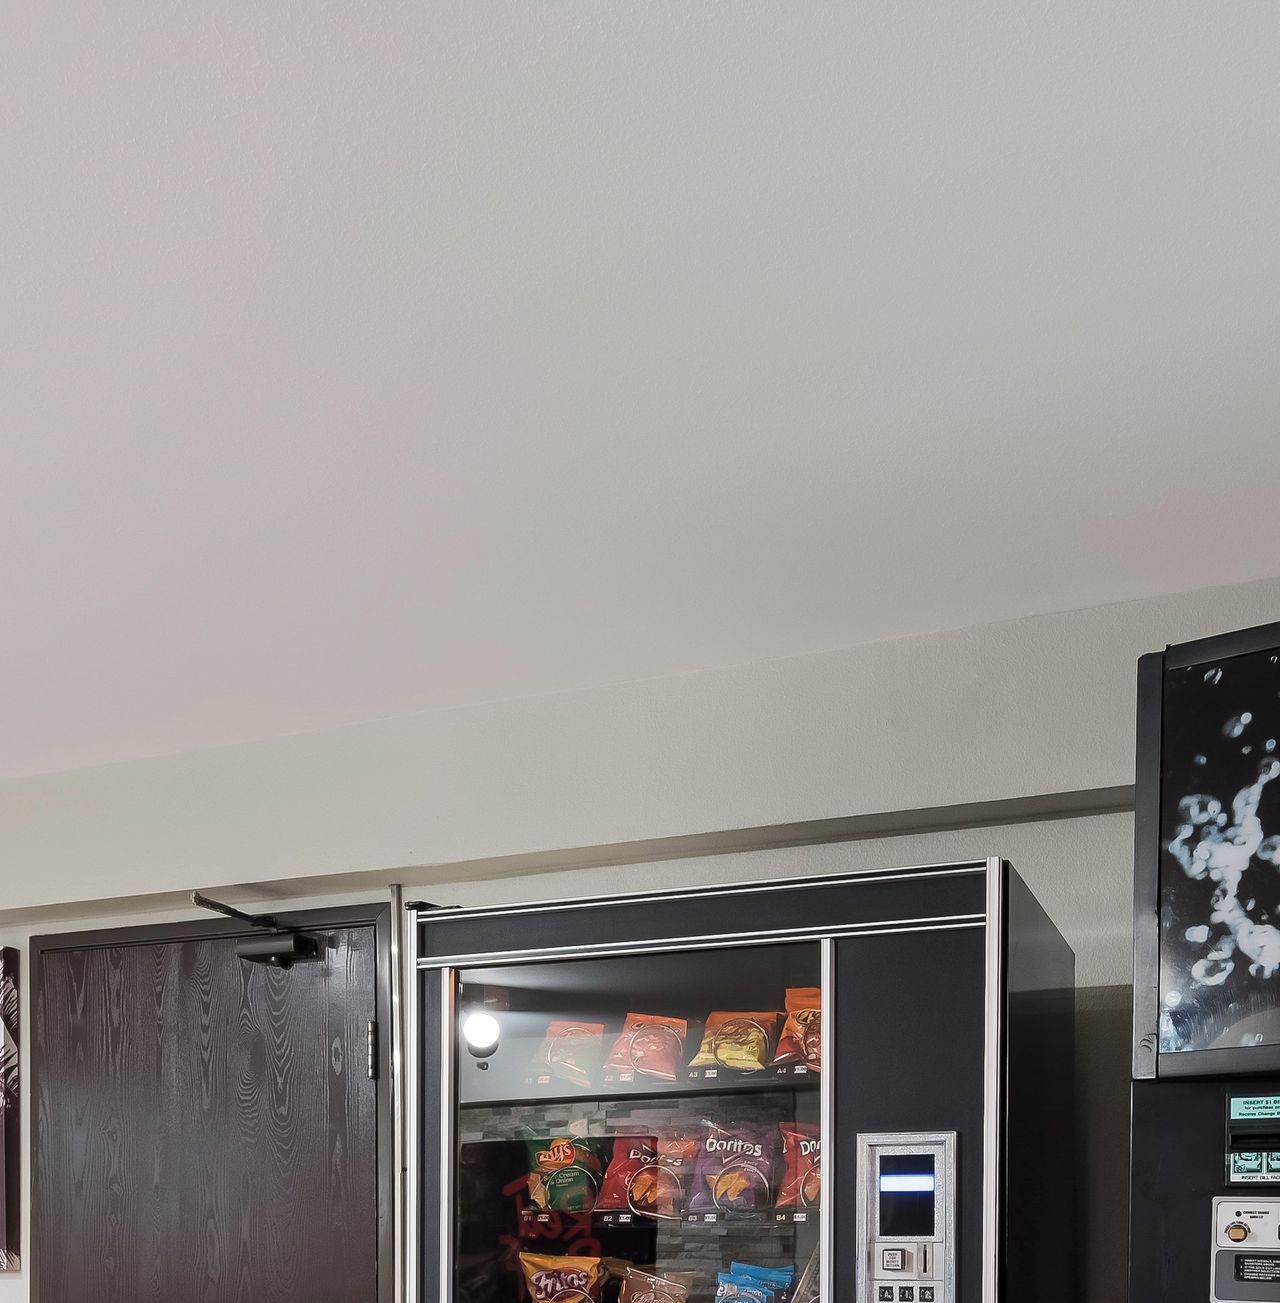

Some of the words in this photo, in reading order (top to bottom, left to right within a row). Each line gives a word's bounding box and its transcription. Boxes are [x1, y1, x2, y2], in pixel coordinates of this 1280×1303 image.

[706, 1138, 762, 1156] Doritos
[559, 1171, 579, 1180] Cream
[531, 1270, 588, 1299] Fritos
